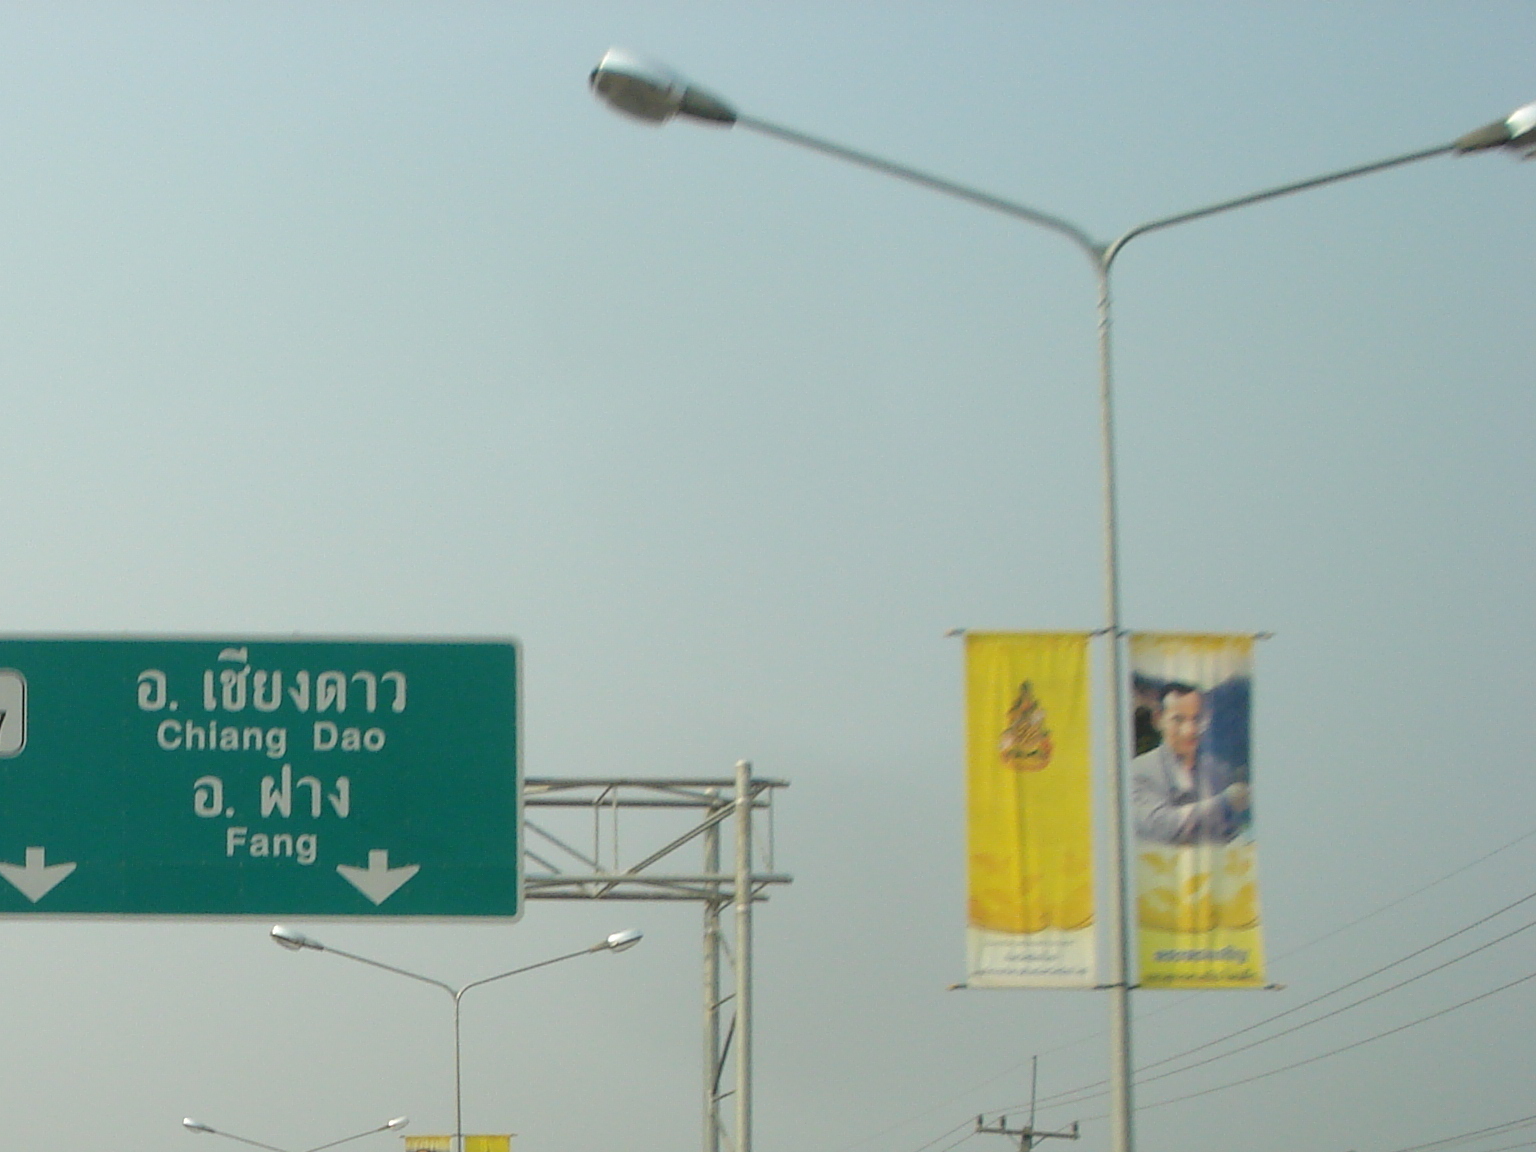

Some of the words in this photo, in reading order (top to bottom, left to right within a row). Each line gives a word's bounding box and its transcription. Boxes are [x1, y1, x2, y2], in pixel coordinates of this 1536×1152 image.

[202, 646, 408, 714] เชียงดาว
[156, 718, 288, 760] Chiang
[313, 720, 387, 752] Dao
[260, 763, 351, 819] ฝาง
[225, 826, 318, 866] Fang
